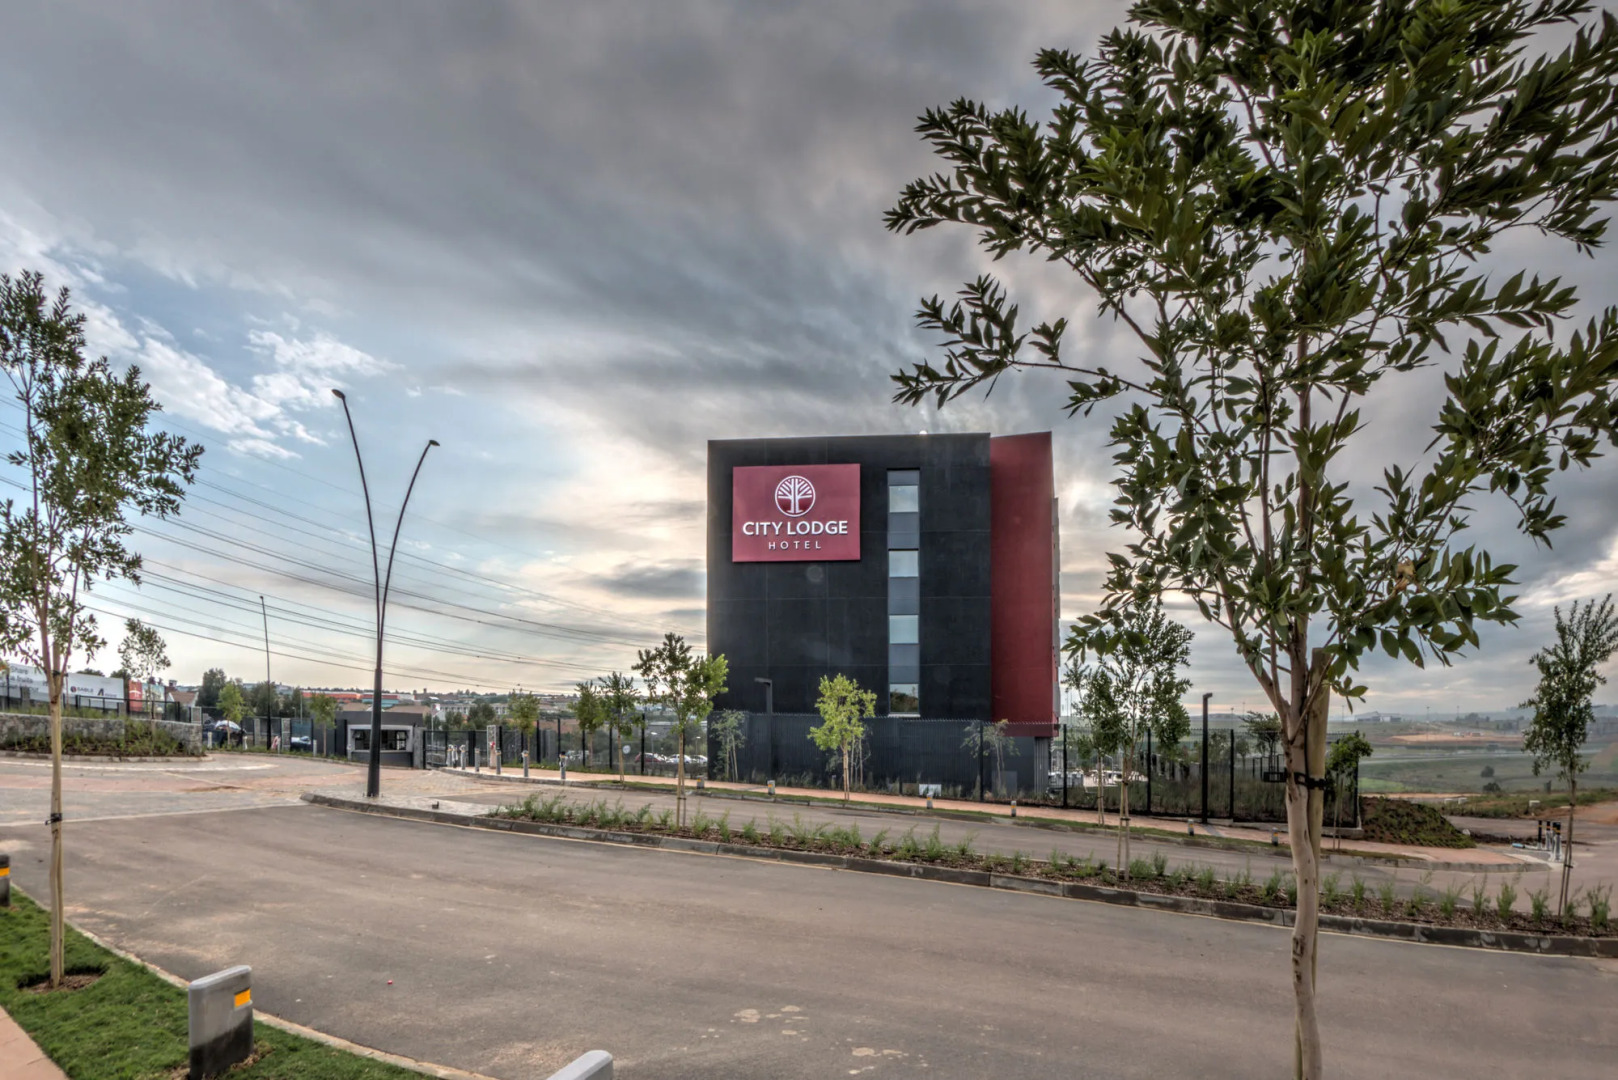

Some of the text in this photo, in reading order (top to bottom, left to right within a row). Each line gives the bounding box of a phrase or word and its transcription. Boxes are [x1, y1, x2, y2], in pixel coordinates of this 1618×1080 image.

[742, 520, 849, 536] CITY LODGE
[768, 540, 822, 550] HOTEL
